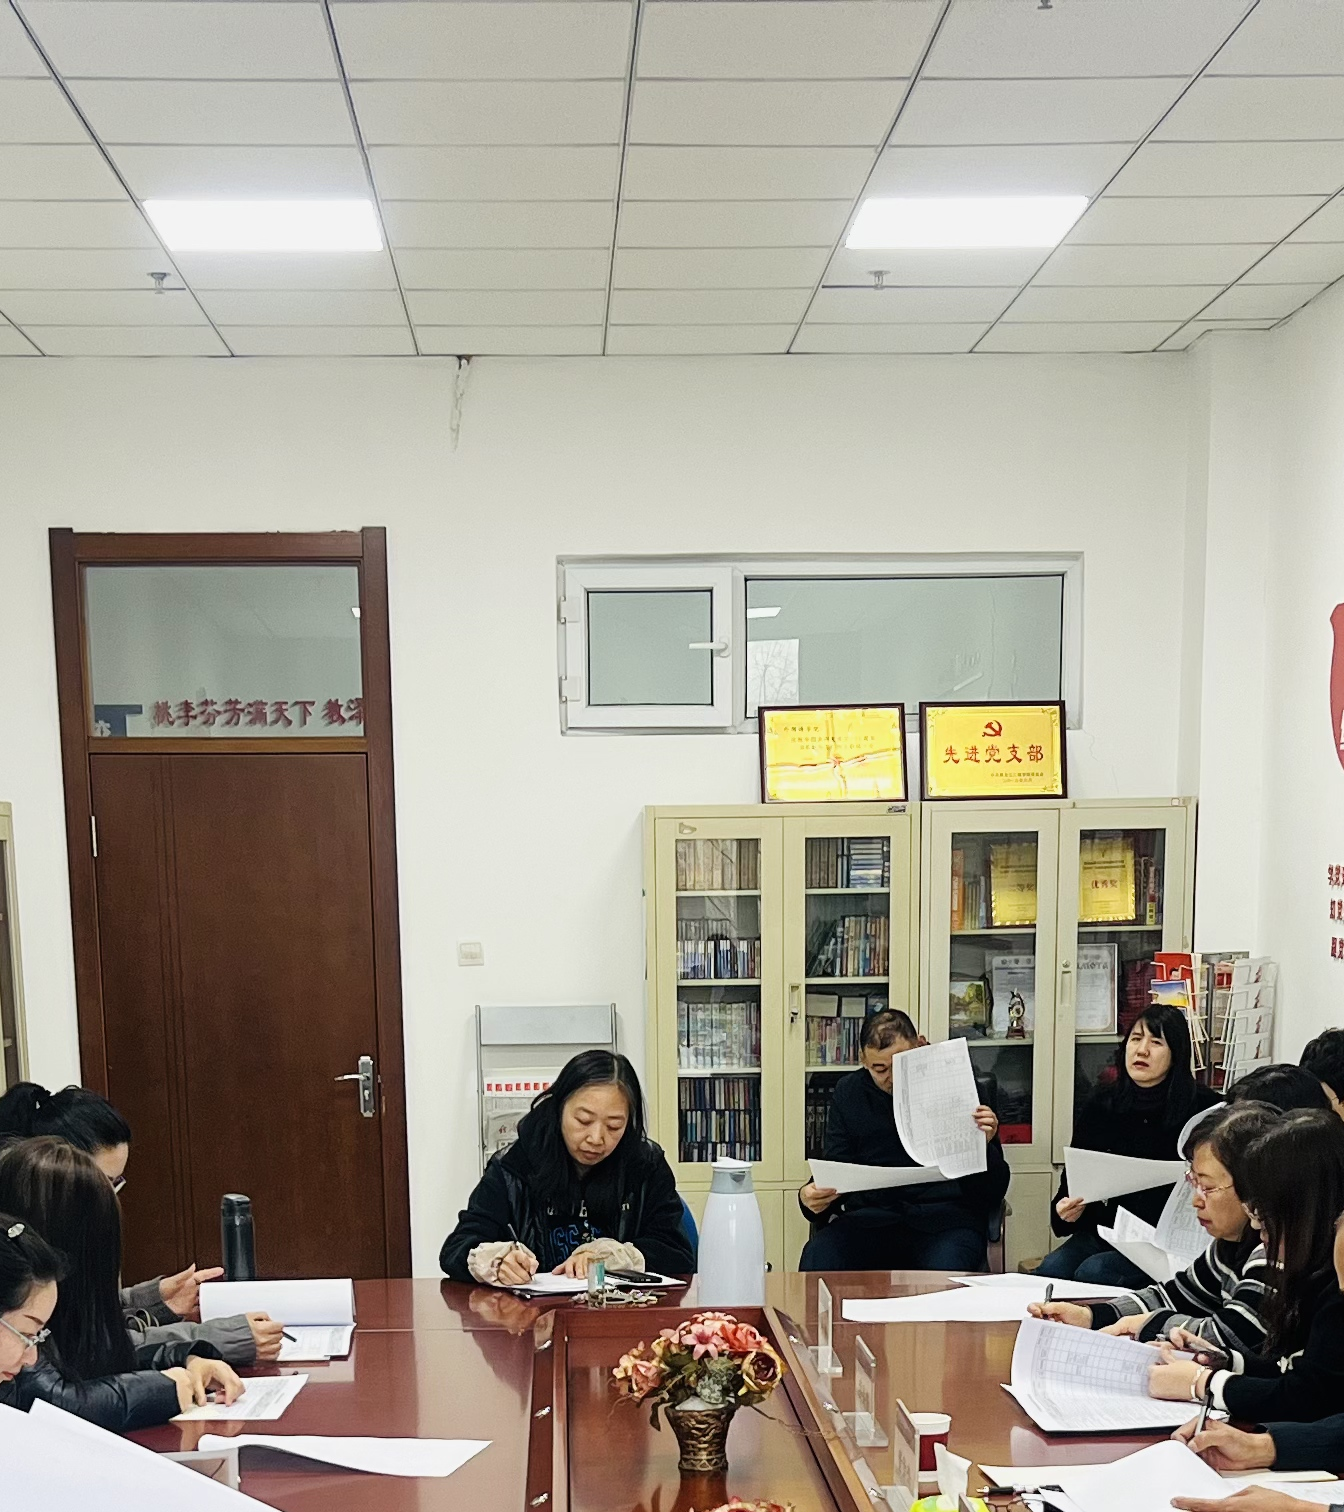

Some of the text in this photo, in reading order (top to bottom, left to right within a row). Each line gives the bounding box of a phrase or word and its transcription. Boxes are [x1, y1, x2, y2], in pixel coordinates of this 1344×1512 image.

[943, 743, 1044, 764] 先进党支部
